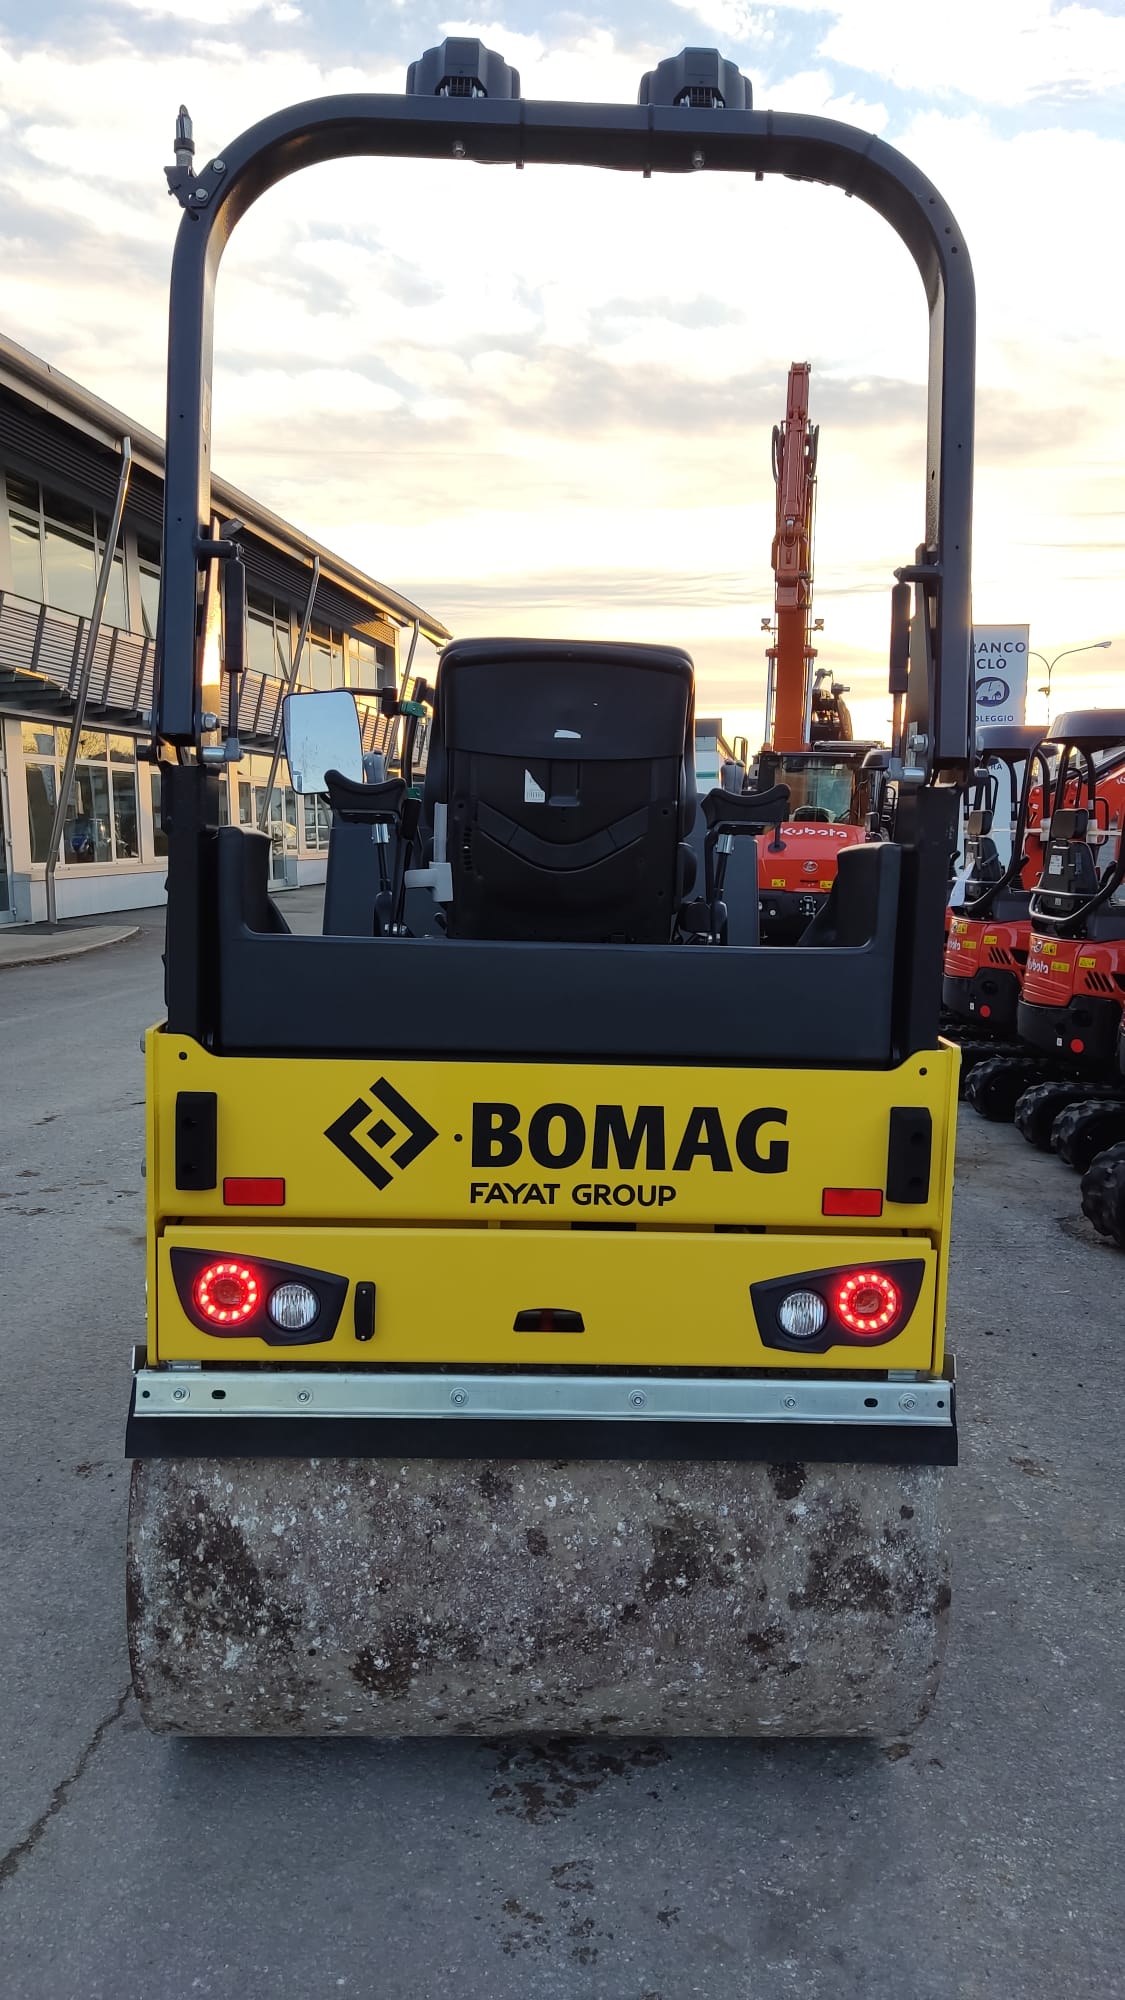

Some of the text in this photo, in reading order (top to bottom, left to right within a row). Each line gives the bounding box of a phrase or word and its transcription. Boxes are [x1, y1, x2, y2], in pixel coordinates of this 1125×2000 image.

[977, 654, 1007, 669] CLÒ
[780, 827, 848, 838] Kubota
[471, 1103, 790, 1174] BOMAG
[470, 1183, 677, 1207] FAYAT GROUP
